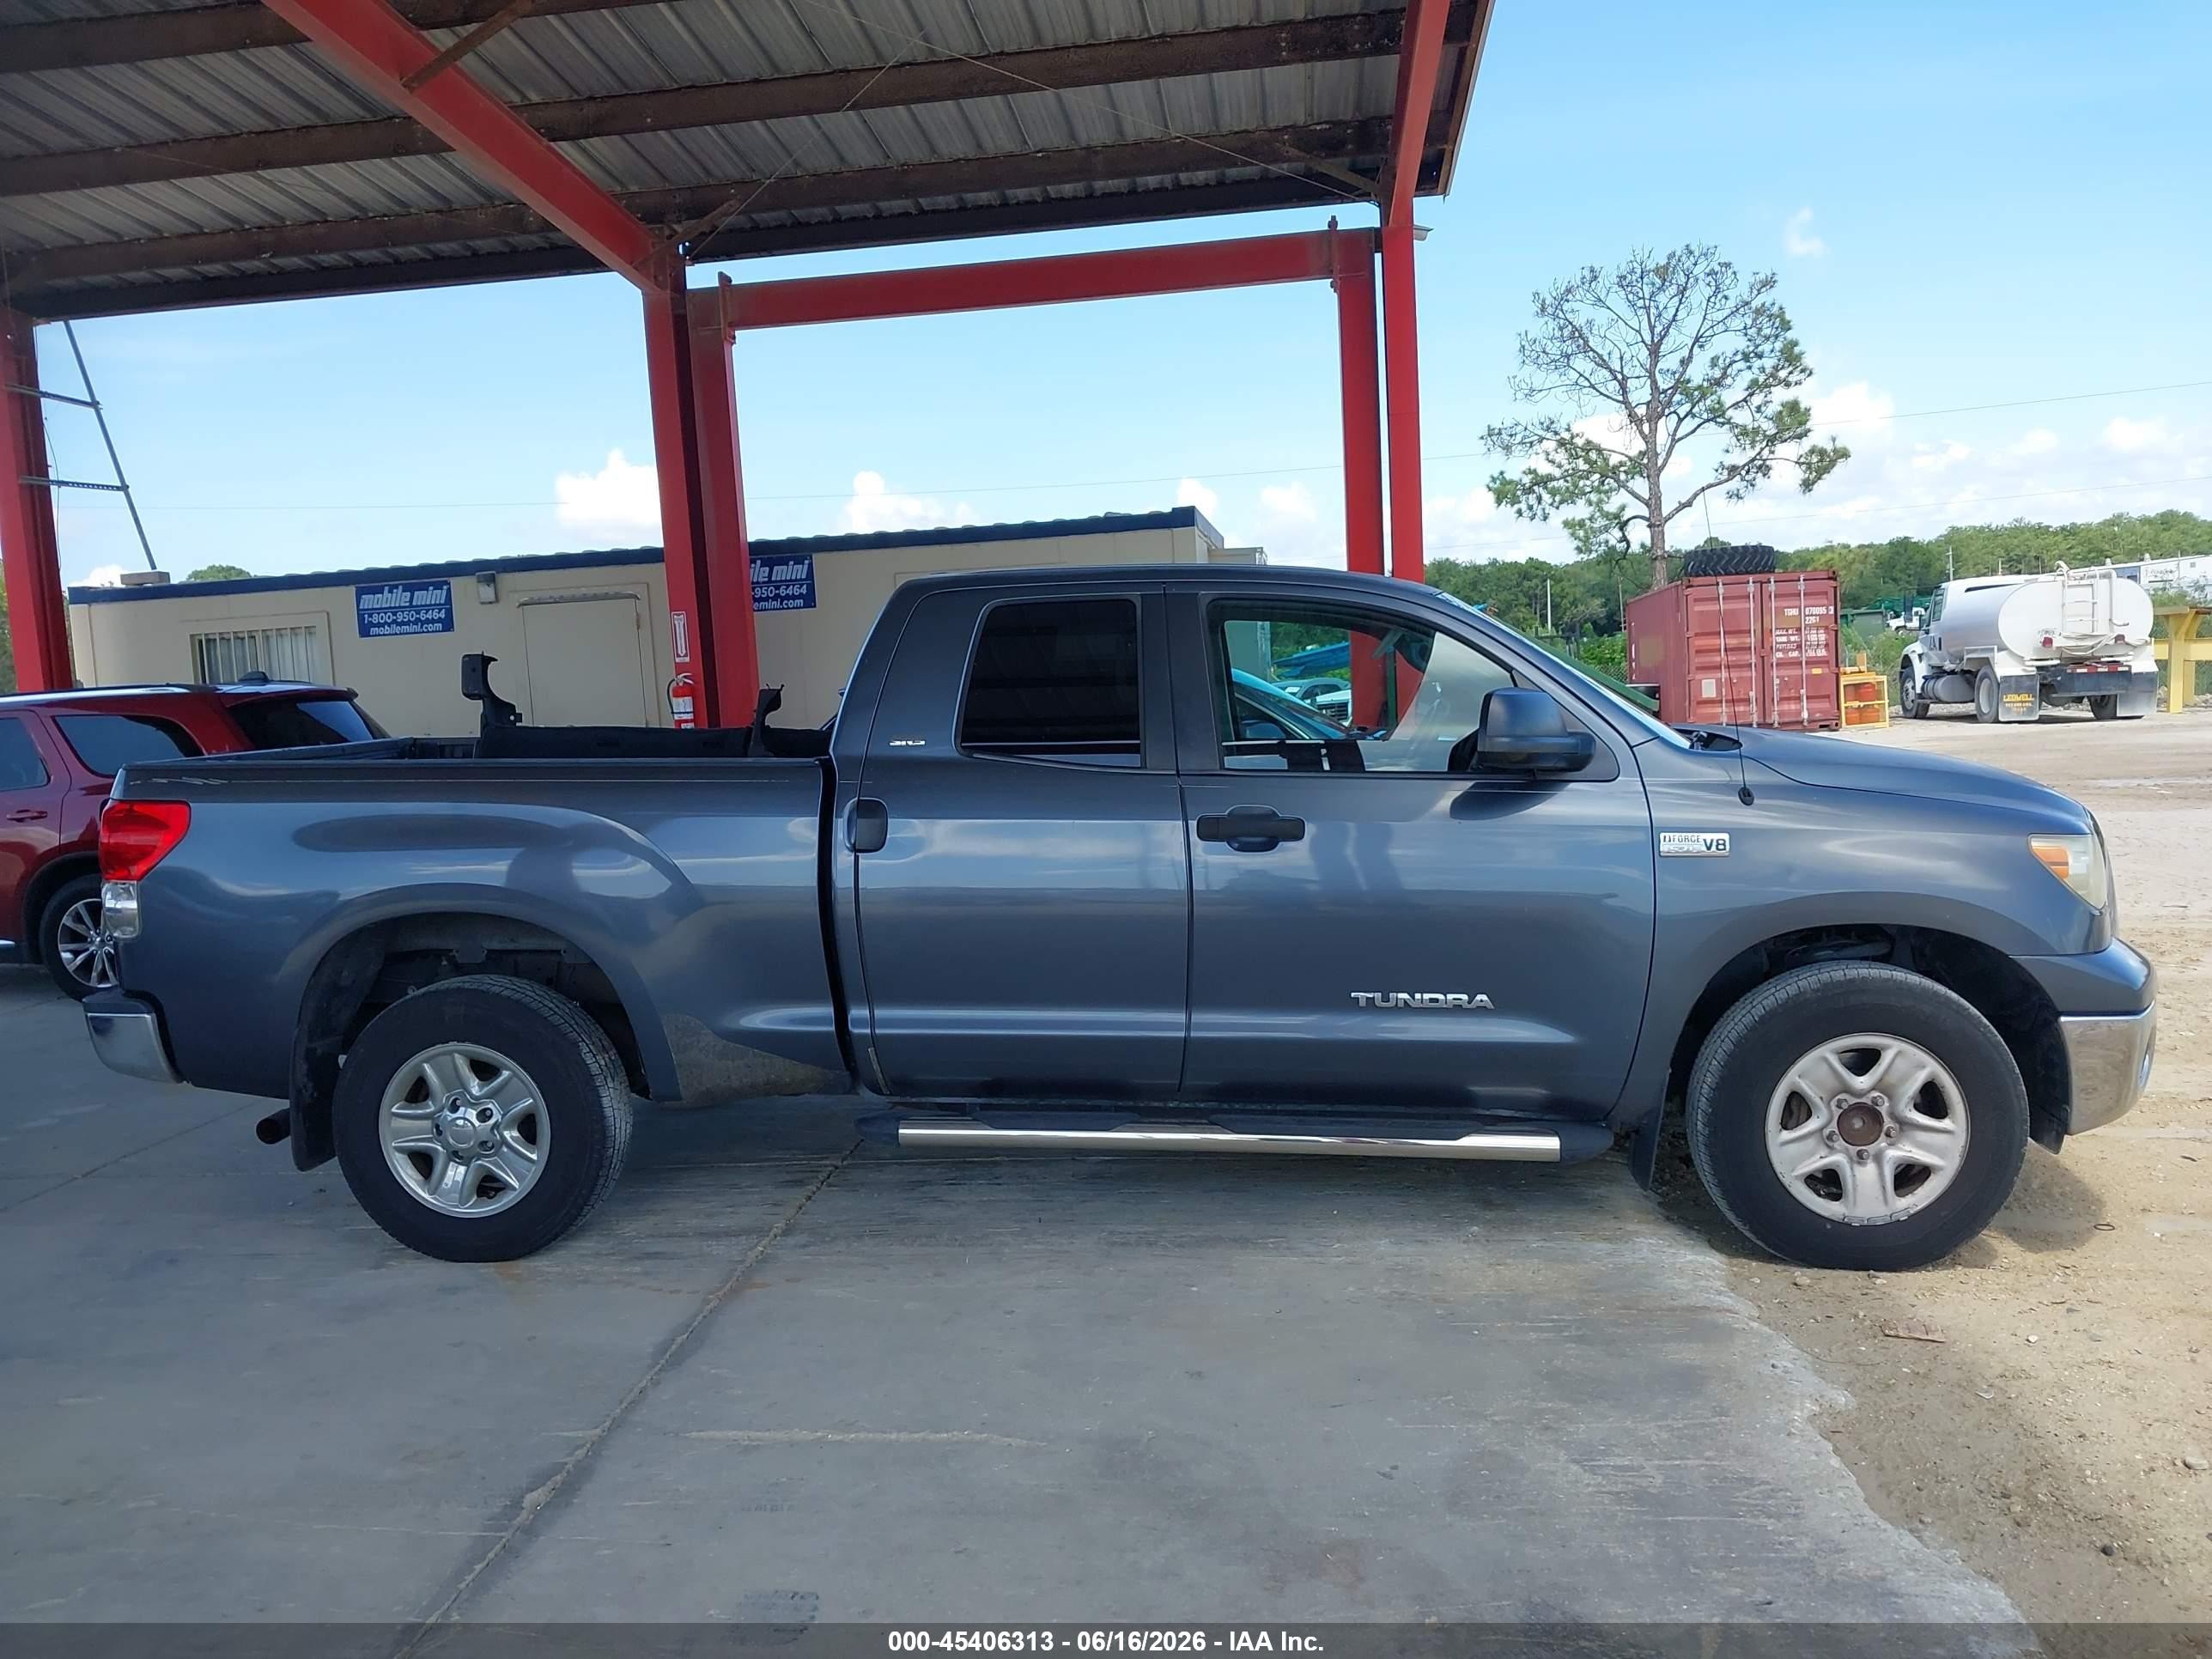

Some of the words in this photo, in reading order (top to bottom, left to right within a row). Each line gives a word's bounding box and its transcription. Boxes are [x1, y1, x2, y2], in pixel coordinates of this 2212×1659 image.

[772, 560, 809, 580] mini
[360, 586, 410, 609] mobile
[412, 586, 447, 605] mini
[364, 609, 446, 624] 1-800-950-6464
[370, 623, 443, 635] mobilemini.com
[1703, 838, 1727, 851] V8
[1351, 992, 1495, 1009] TUNDRA
